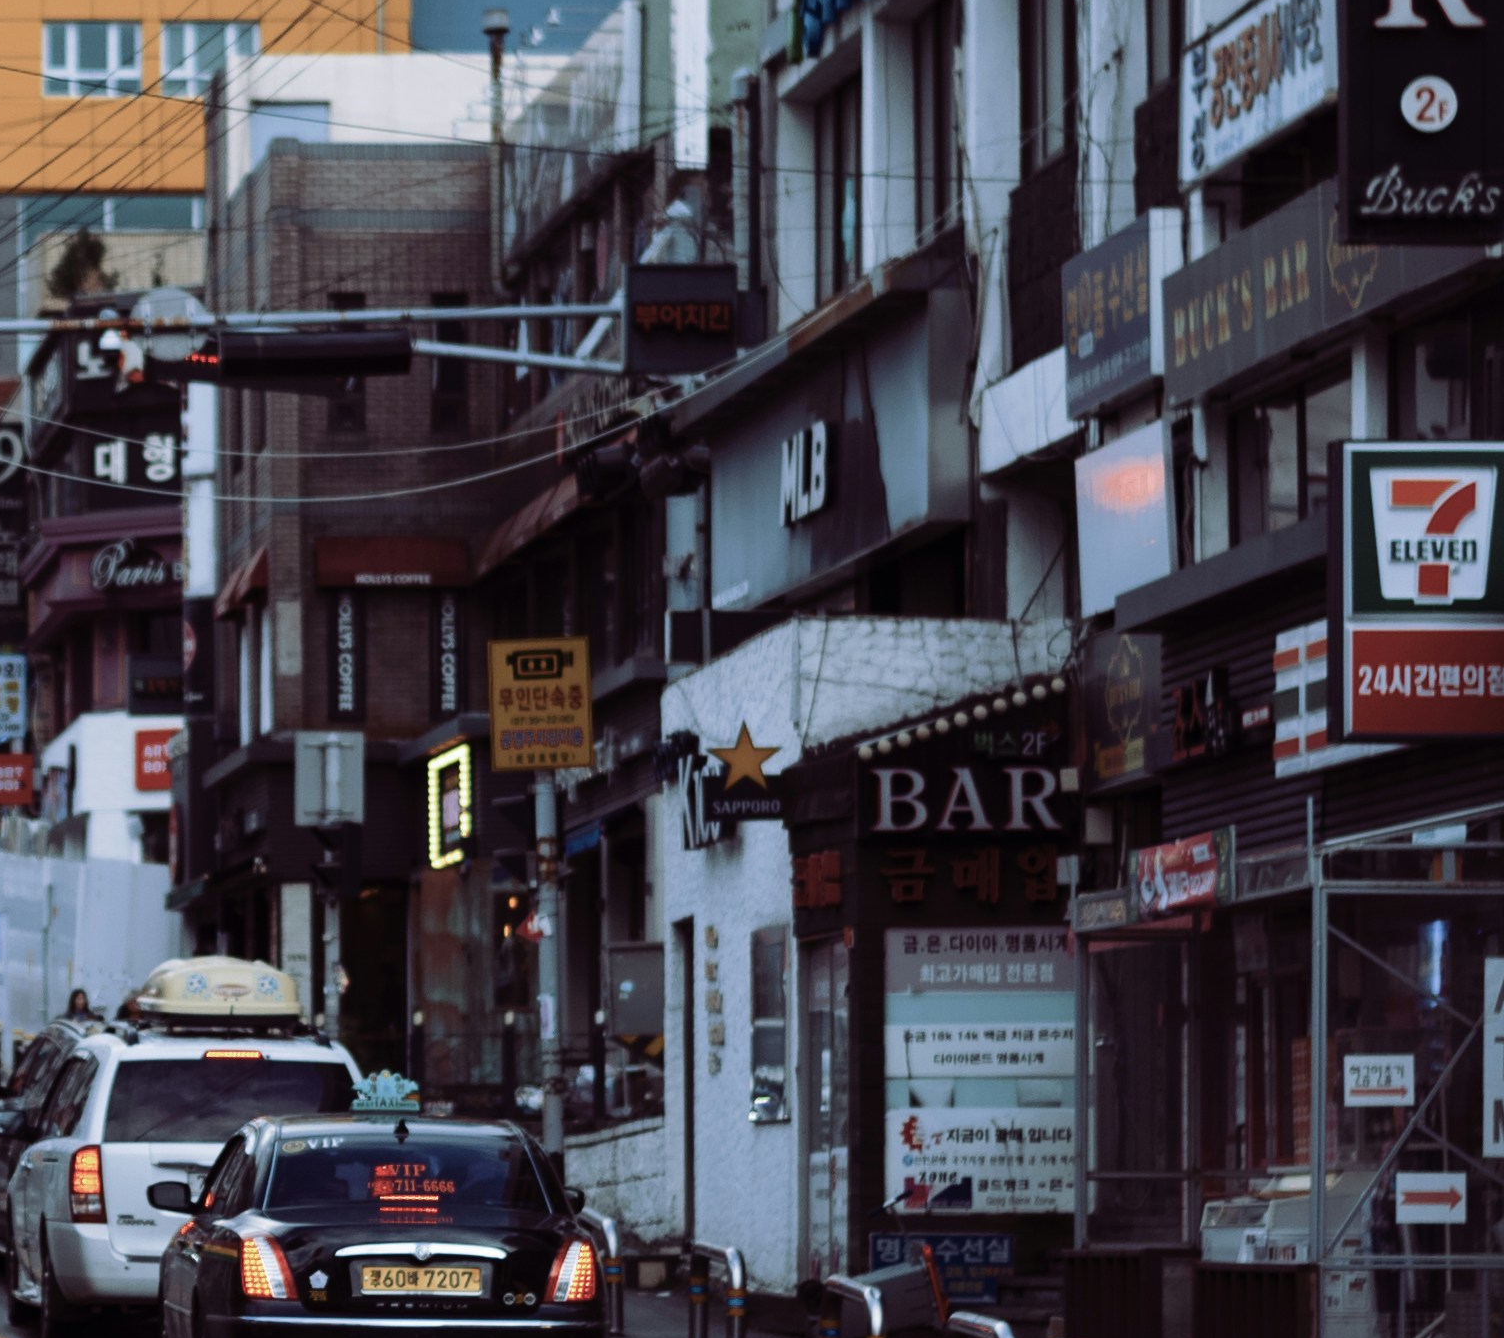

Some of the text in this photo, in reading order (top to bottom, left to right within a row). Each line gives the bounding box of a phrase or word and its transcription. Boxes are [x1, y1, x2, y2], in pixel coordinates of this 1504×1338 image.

[1359, 165, 1502, 218] Buck's
[1174, 267, 1254, 369] BUCK'S
[1263, 238, 1310, 320] BAR
[779, 419, 827, 529] MLB
[92, 536, 168, 591] Paris
[393, 573, 432, 585] COFFEE
[337, 652, 354, 711] COFFEE
[440, 652, 456, 711] COFFEE
[499, 684, 584, 713] 무인단속중
[711, 798, 782, 815] SAPPORO
[870, 765, 1064, 833] BAR
[306, 1137, 344, 1150] VIP
[391, 1163, 428, 1178] VIP
[935, 1237, 1011, 1264] 수선실
[424, 1269, 473, 1289] 7207
